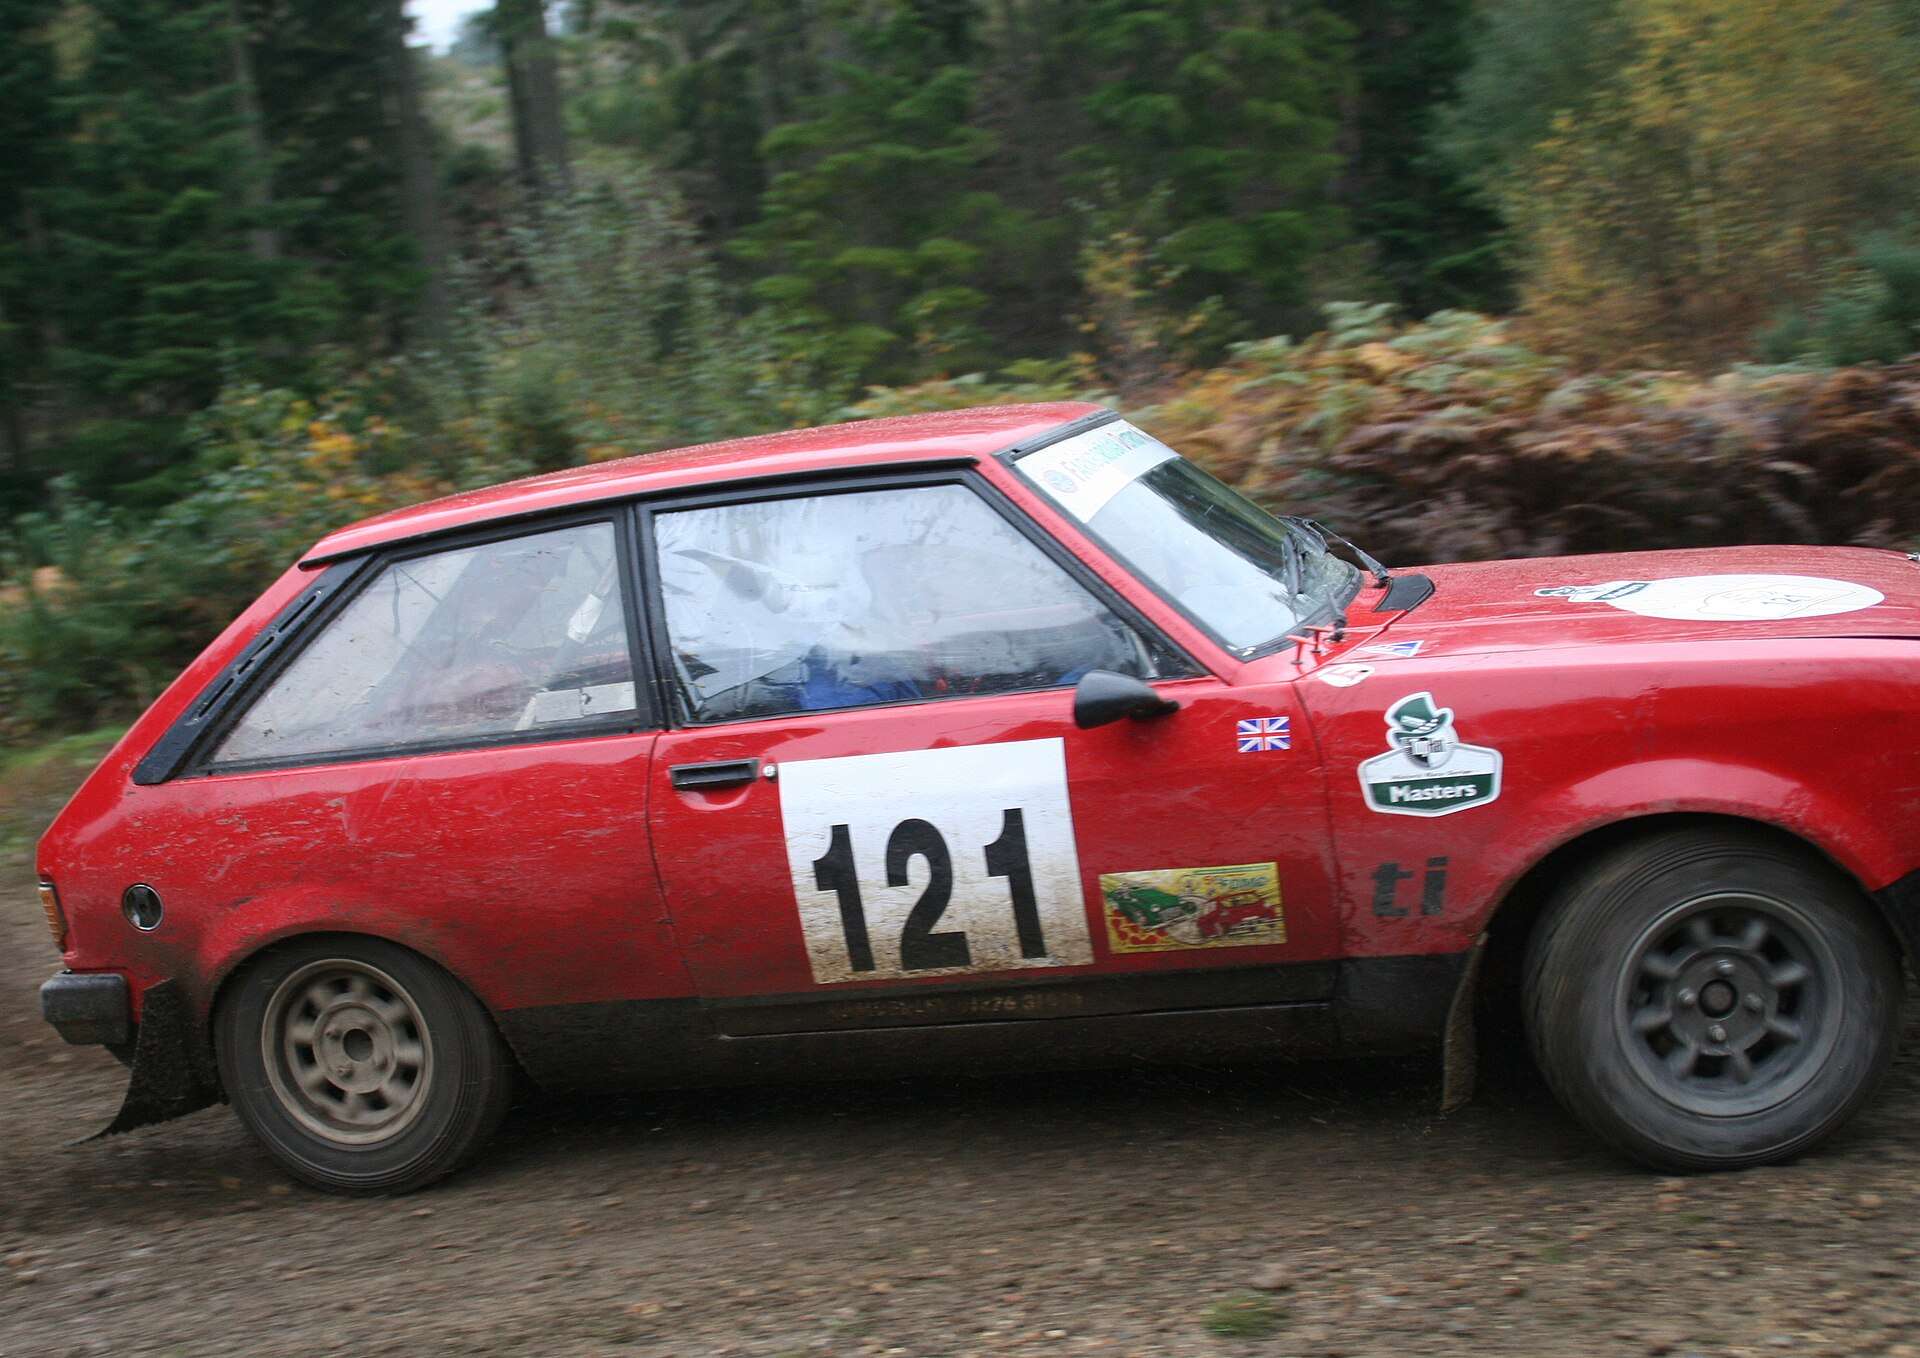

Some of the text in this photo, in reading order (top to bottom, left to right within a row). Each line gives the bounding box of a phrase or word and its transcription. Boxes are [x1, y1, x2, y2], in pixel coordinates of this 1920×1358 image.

[1389, 783, 1478, 803] Masters
[811, 808, 1048, 972] 121
[1371, 855, 1449, 917] ti
